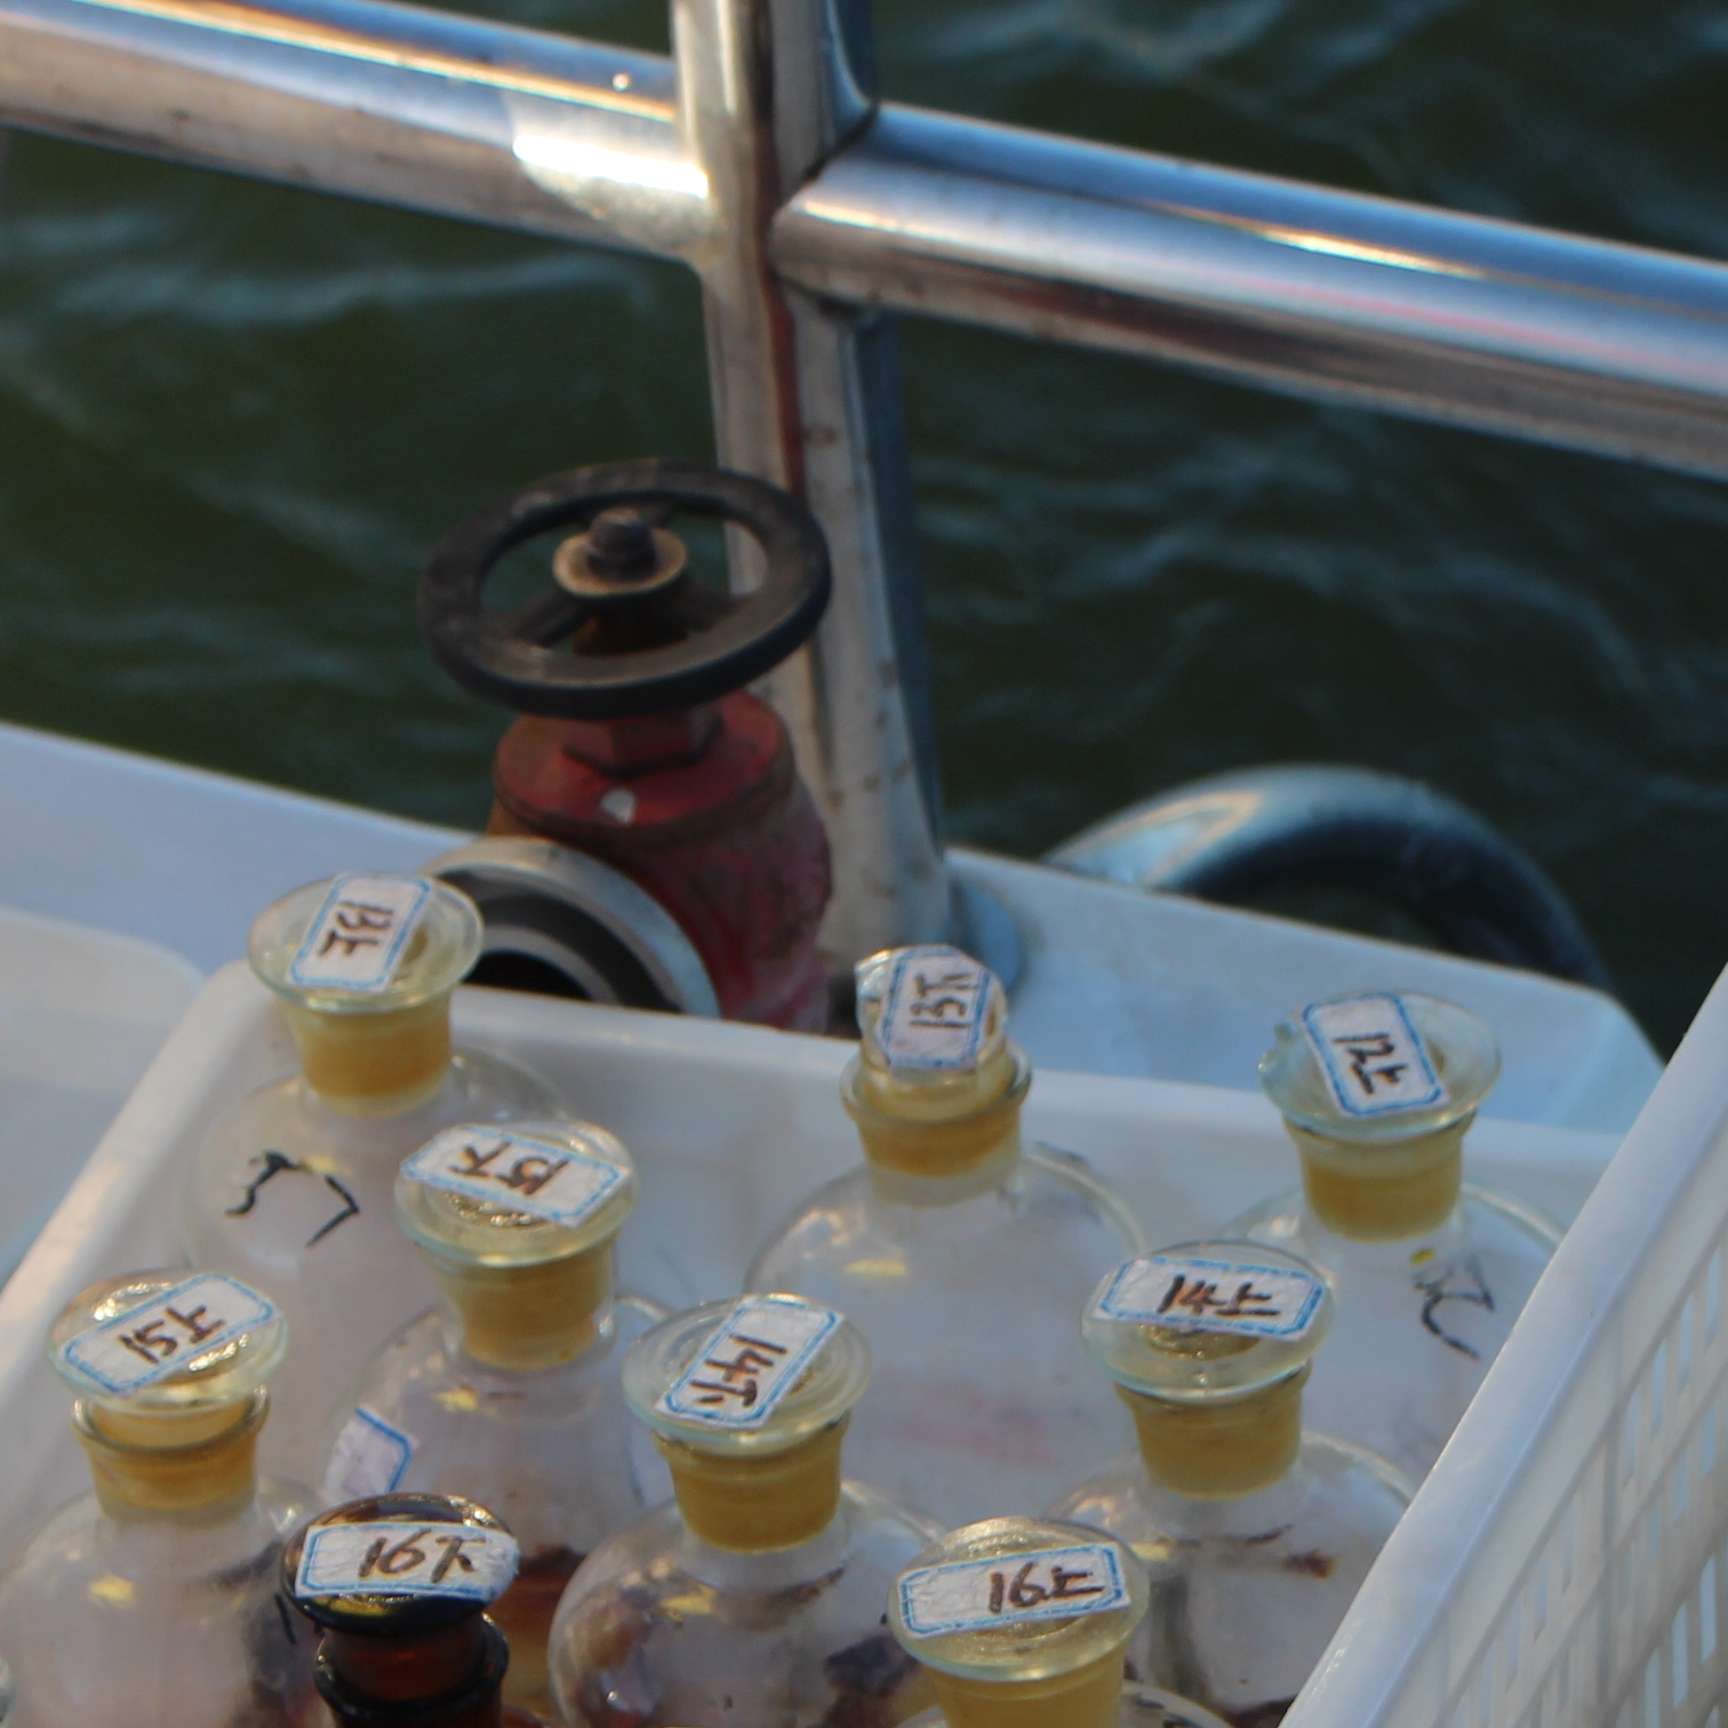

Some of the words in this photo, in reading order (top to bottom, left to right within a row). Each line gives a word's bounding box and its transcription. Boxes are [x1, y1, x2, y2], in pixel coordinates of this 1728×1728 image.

[1332, 1030, 1416, 1095] 12上
[1155, 1274, 1282, 1320] 14上
[116, 1304, 227, 1365] 15上
[358, 1526, 488, 1585] 16下
[986, 1561, 1106, 1615] 16上
